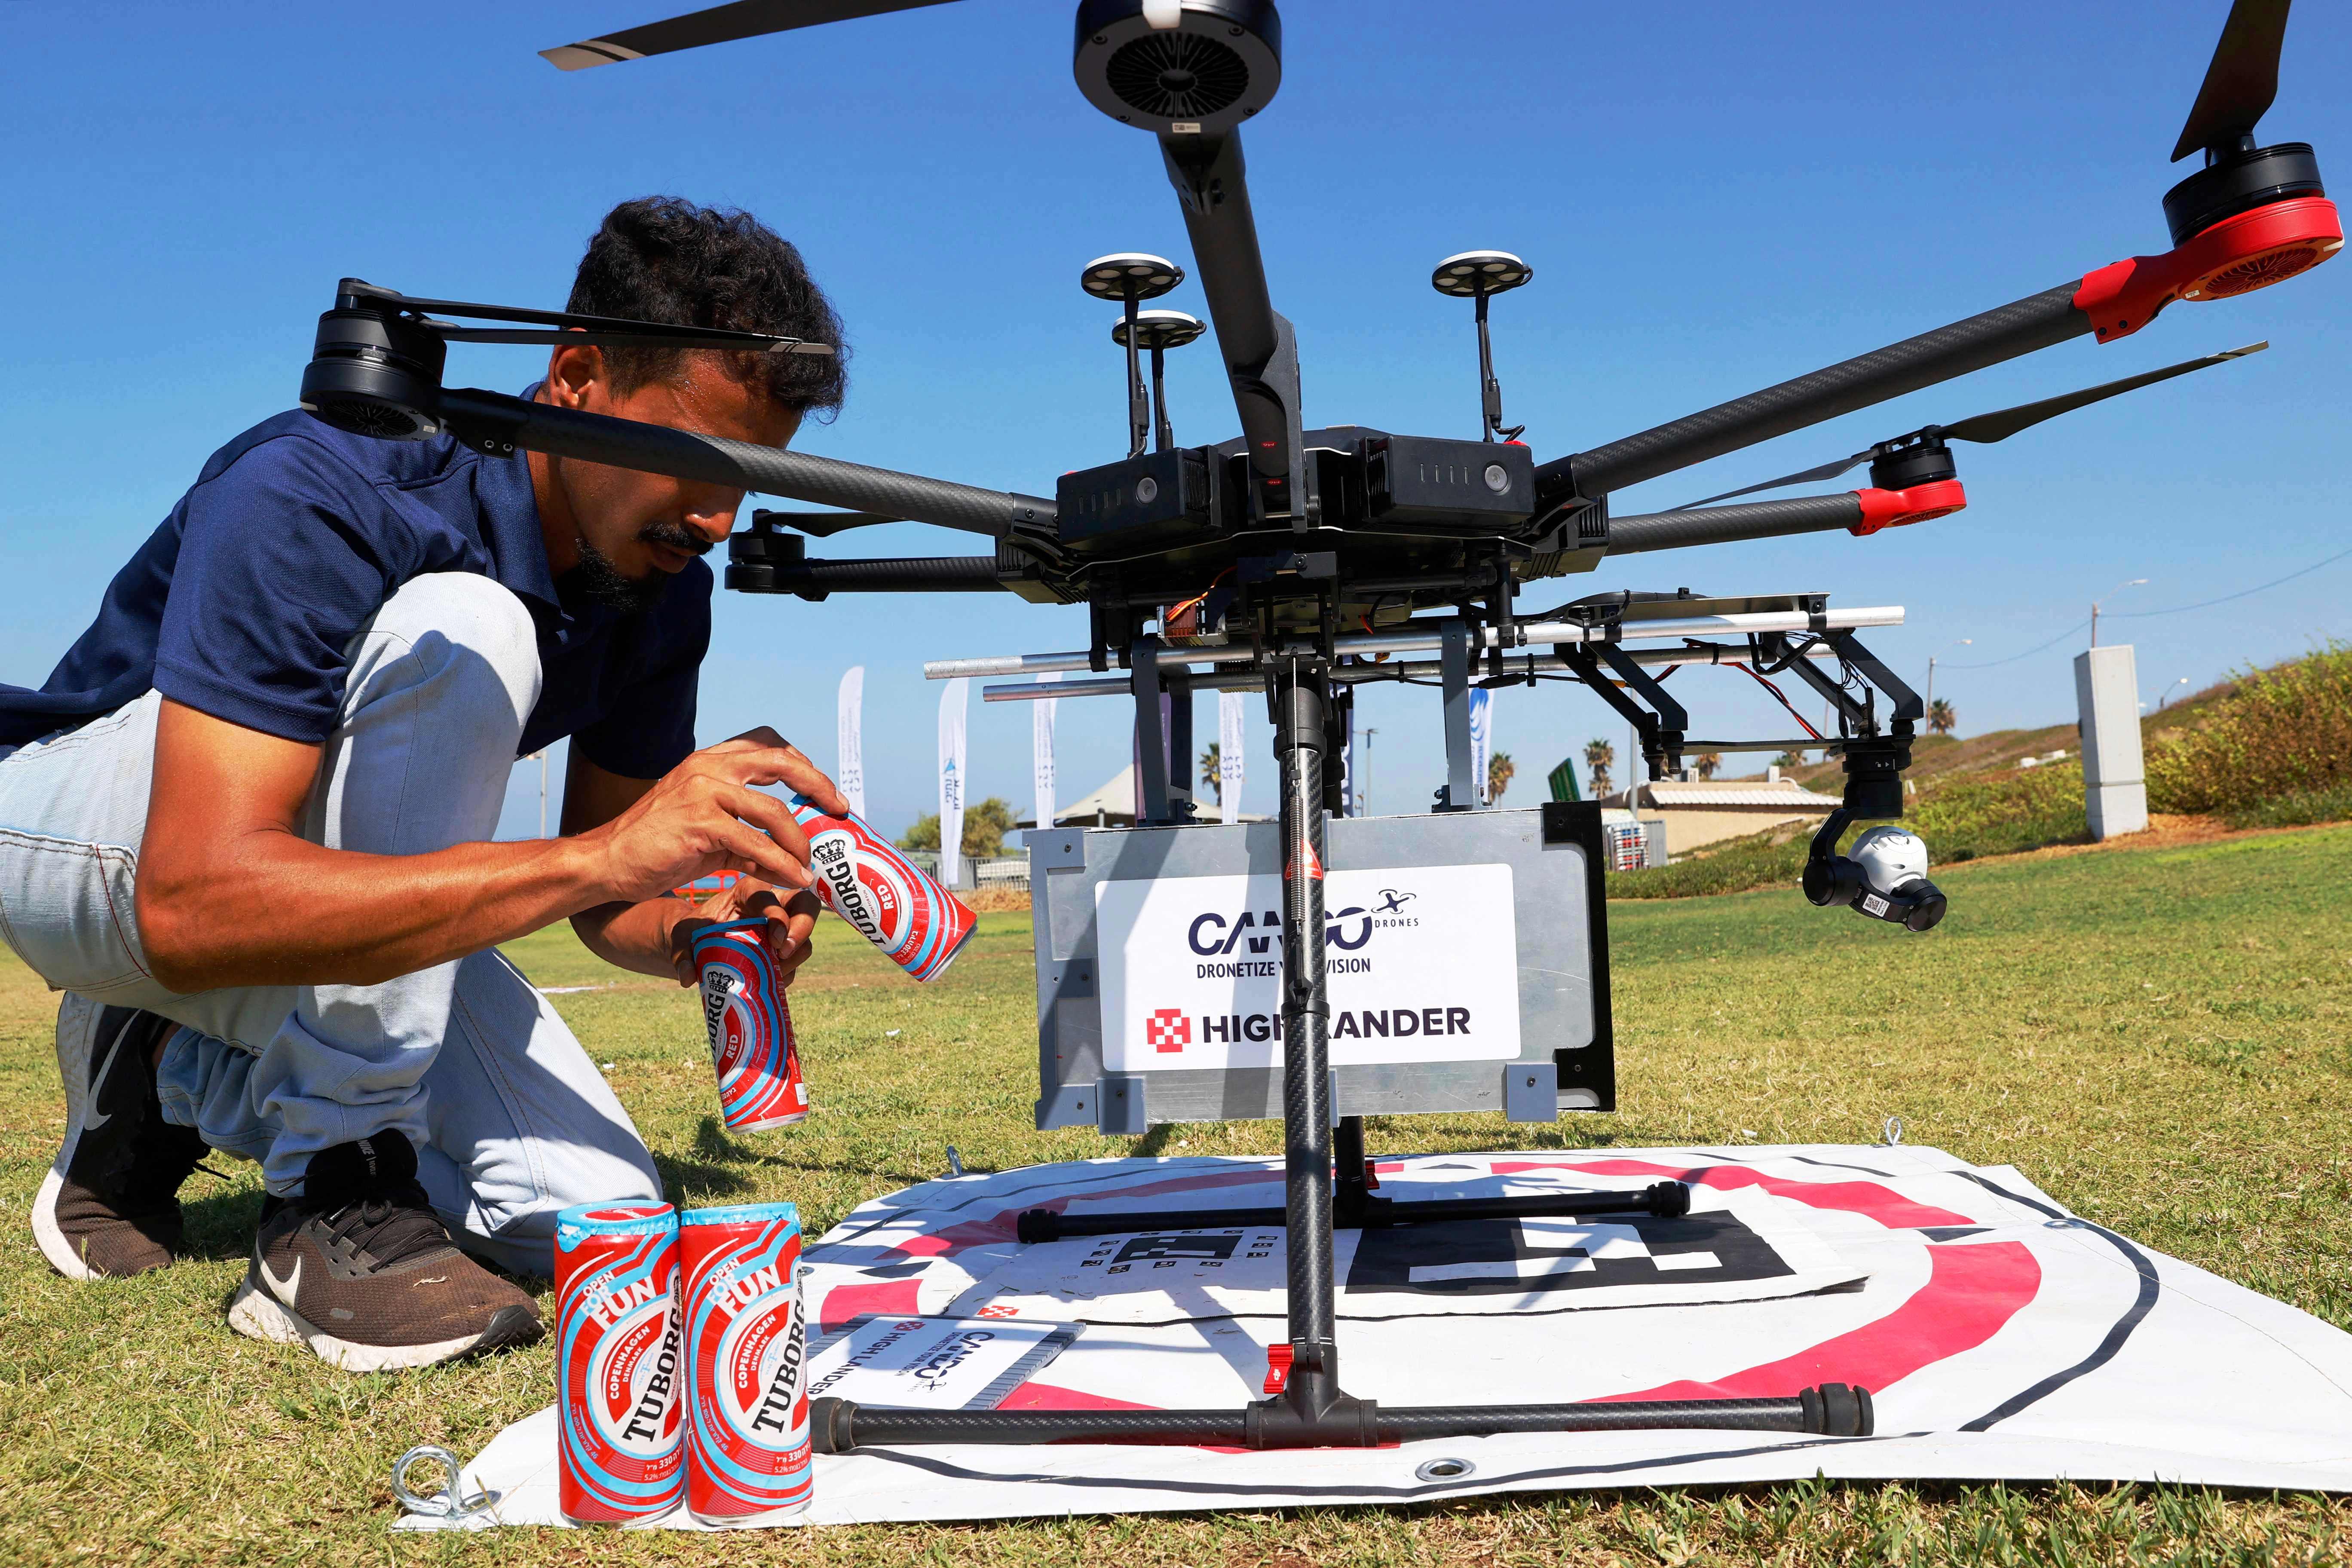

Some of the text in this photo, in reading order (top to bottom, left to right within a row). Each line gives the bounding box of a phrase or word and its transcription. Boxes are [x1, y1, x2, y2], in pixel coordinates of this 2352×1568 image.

[826, 861, 886, 946] TUBORG
[877, 884, 894, 910] RED
[1188, 907, 1372, 956] CANO
[1375, 918, 1418, 928] DRONES
[900, 944, 911, 955] 330
[907, 931, 919, 946] בירה
[1197, 962, 1275, 978] DRONETIZE
[1326, 958, 1371, 974] VISION
[1328, 1007, 1471, 1039] ANDER
[726, 1034, 738, 1059] RED
[356, 1139, 375, 1155] NIKE
[583, 1270, 616, 1297] OPEN
[709, 1258, 741, 1285] OPEN
[579, 1284, 613, 1317] FOR
[706, 1272, 738, 1306] FOR
[716, 1263, 781, 1320] FUN
[590, 1275, 657, 1331] FUN
[738, 1314, 776, 1389] COPENHAGEN
[750, 1335, 771, 1371] DENMARK
[861, 1333, 906, 1354] HIGH
[928, 1332, 963, 1352] DRONETIZE
[610, 1325, 651, 1400] COPENHAGEN
[622, 1346, 643, 1383] DENMARK
[622, 1307, 680, 1442] TUBORG
[751, 1299, 805, 1433] TUBORG
[808, 1356, 872, 1395] LANDER
[894, 1361, 921, 1376] VISION
[591, 1451, 598, 1459] 46
[721, 1442, 729, 1452] 46
[788, 1449, 802, 1462] 330
[658, 1455, 673, 1469] 330
